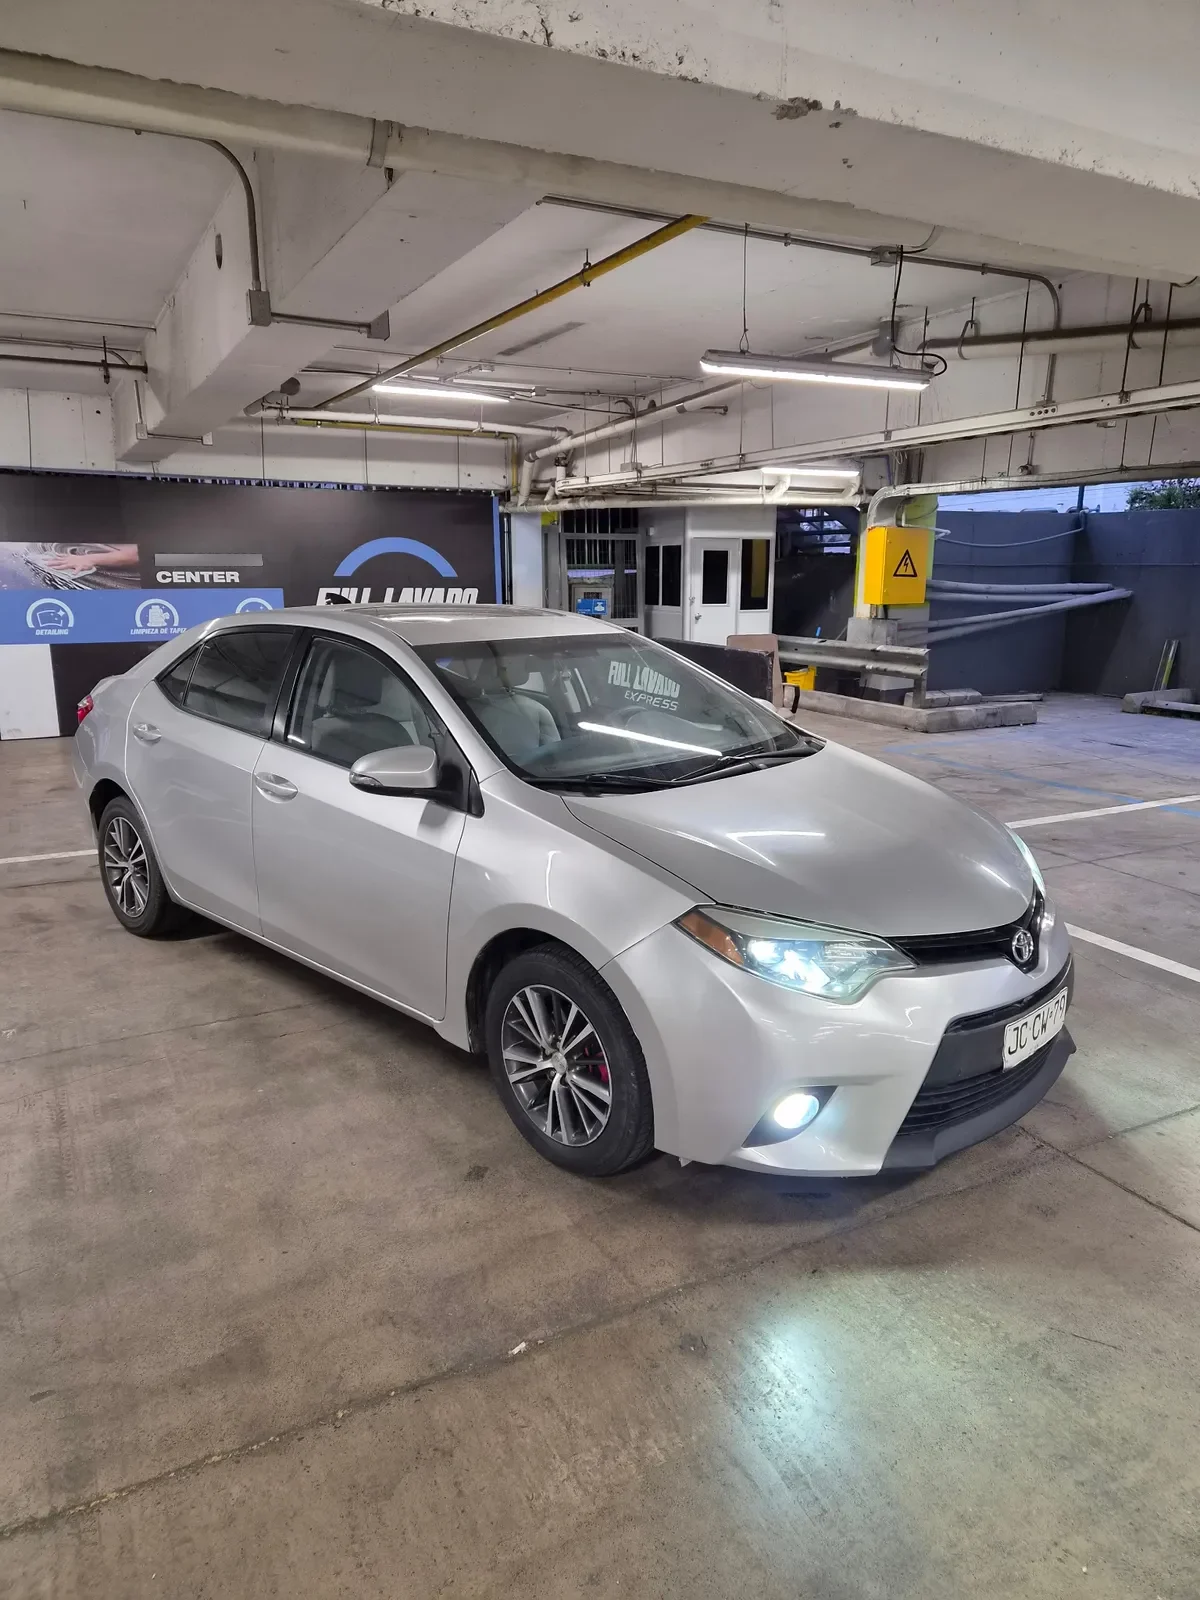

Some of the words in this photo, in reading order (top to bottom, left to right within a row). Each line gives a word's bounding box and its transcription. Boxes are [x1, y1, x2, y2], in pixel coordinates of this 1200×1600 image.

[156, 571, 240, 584] CENTER
[35, 628, 69, 636] DETAILING
[159, 627, 169, 635] DE
[607, 660, 632, 688] FULL
[624, 690, 680, 711] EXPRESS
